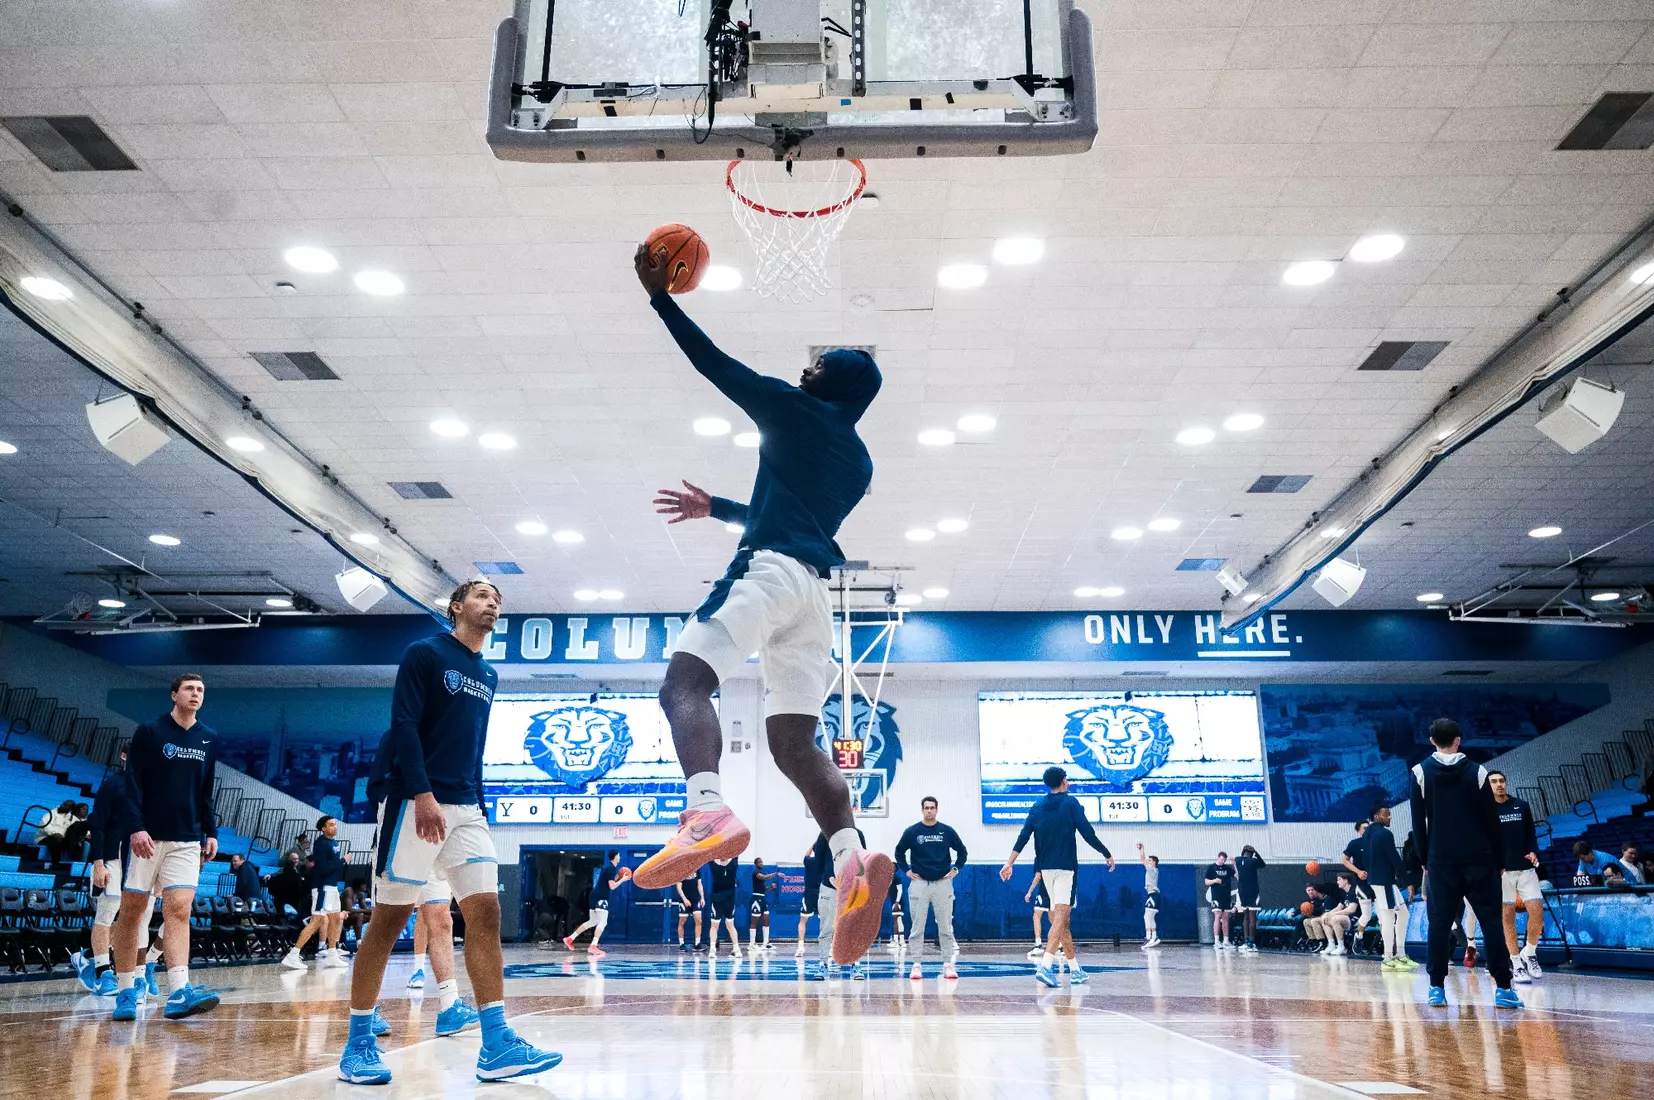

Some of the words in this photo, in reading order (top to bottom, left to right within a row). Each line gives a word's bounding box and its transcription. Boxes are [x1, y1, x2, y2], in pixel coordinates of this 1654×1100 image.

[1084, 614, 1174, 644] ONLY
[838, 750, 858, 767] 30
[500, 802, 514, 817] Y
[529, 805, 538, 815] 0
[562, 802, 592, 811] 41:30
[614, 805, 623, 815] 0
[1109, 801, 1139, 810] 41:30
[1163, 804, 1173, 814] 0
[1573, 875, 1592, 887] POSS.
